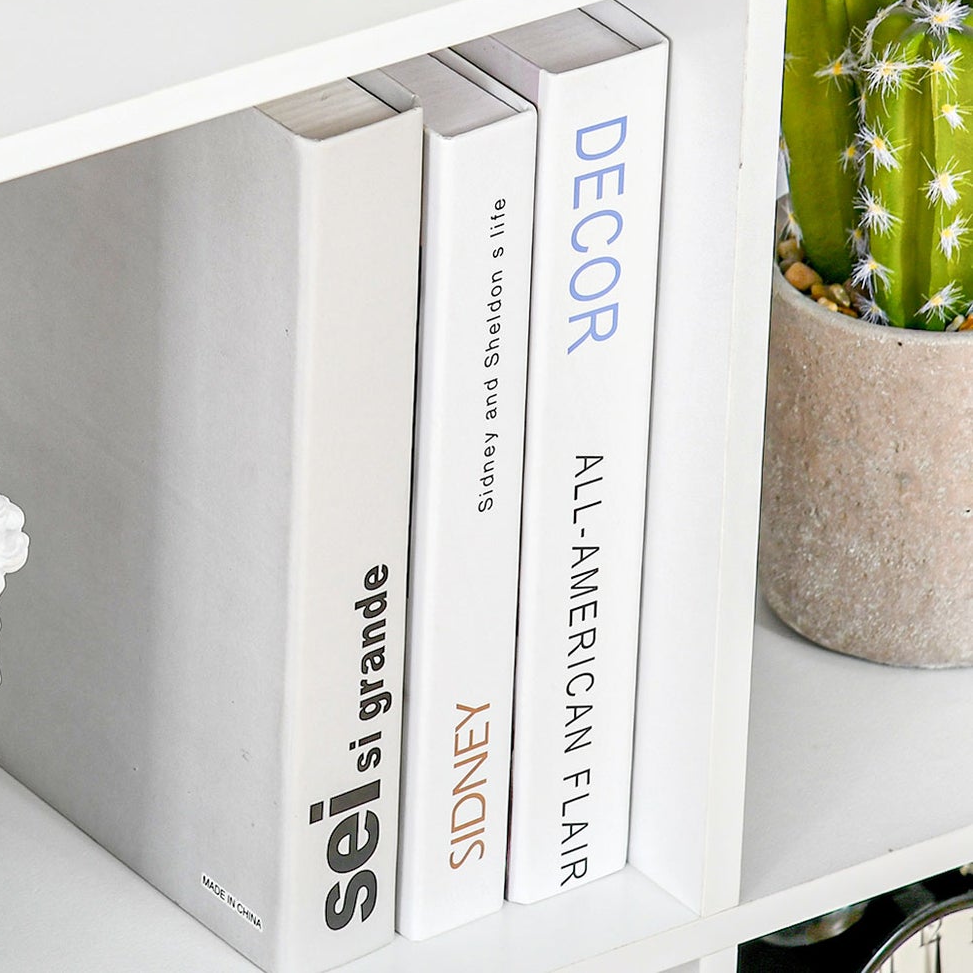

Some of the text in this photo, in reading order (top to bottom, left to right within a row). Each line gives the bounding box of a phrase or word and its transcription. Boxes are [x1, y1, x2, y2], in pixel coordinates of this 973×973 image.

[490, 199, 506, 237] life
[568, 117, 627, 353] DECOR
[484, 271, 502, 367] Sheldon
[484, 378, 498, 420] and
[478, 433, 498, 512] Sidney
[561, 456, 603, 886] ALL-AMERICAN FLAIR
[309, 564, 392, 930] sei si grande
[448, 704, 490, 869] SIDNEY
[202, 875, 262, 929] MADE IN CHINA
